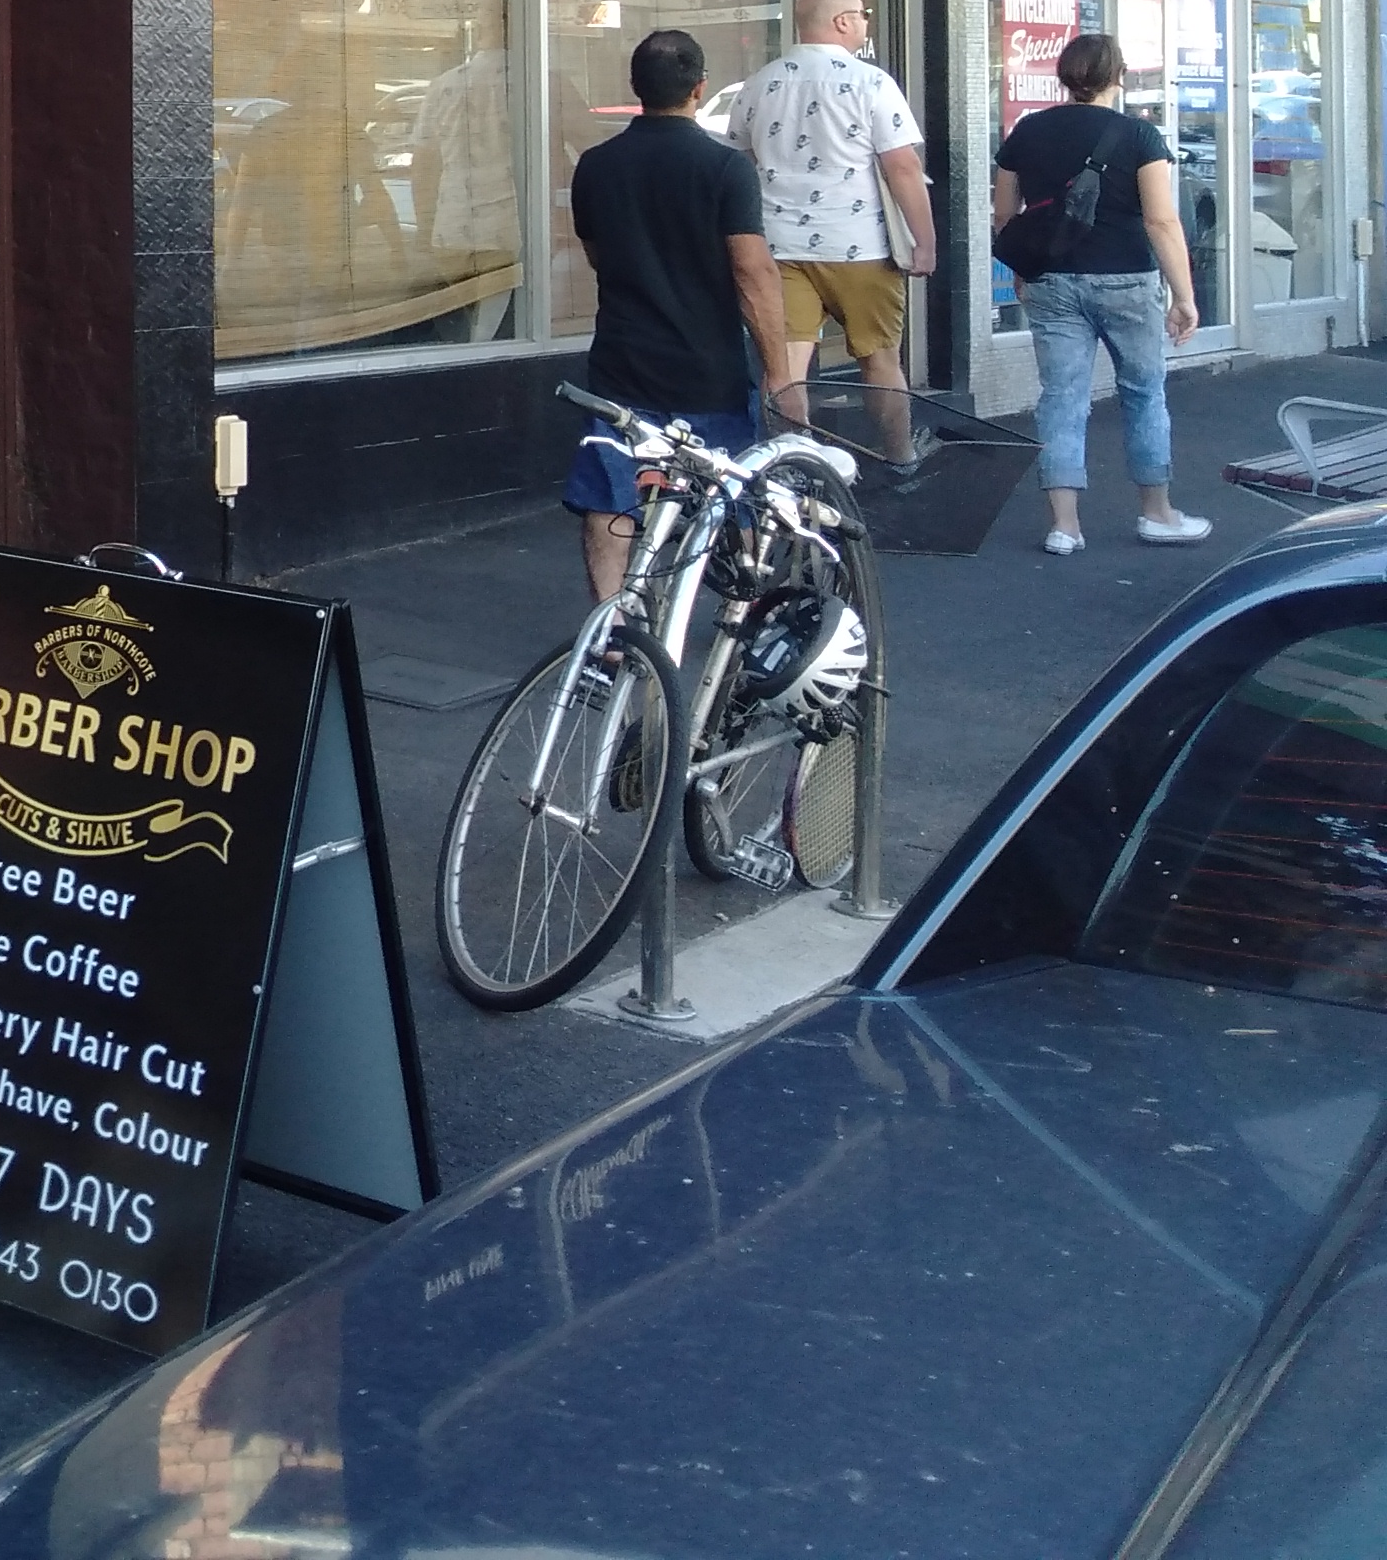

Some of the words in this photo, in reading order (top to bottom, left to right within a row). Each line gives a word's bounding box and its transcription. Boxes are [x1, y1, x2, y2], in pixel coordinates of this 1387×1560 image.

[1008, 75, 1015, 102] 3
[34, 624, 83, 653] BARBERS
[87, 624, 101, 636] OF
[104, 628, 157, 682] NORTHCOTE
[113, 714, 257, 794] SHOP
[46, 816, 61, 841] &
[66, 819, 134, 847] SHAVE
[54, 868, 136, 921] Beer
[23, 935, 140, 998] Coffee
[52, 1017, 129, 1071] Hair
[141, 1044, 207, 1096] Cut
[94, 1102, 209, 1167] Colour
[39, 1162, 156, 1244] DAYS
[59, 1260, 159, 1324] 0130
